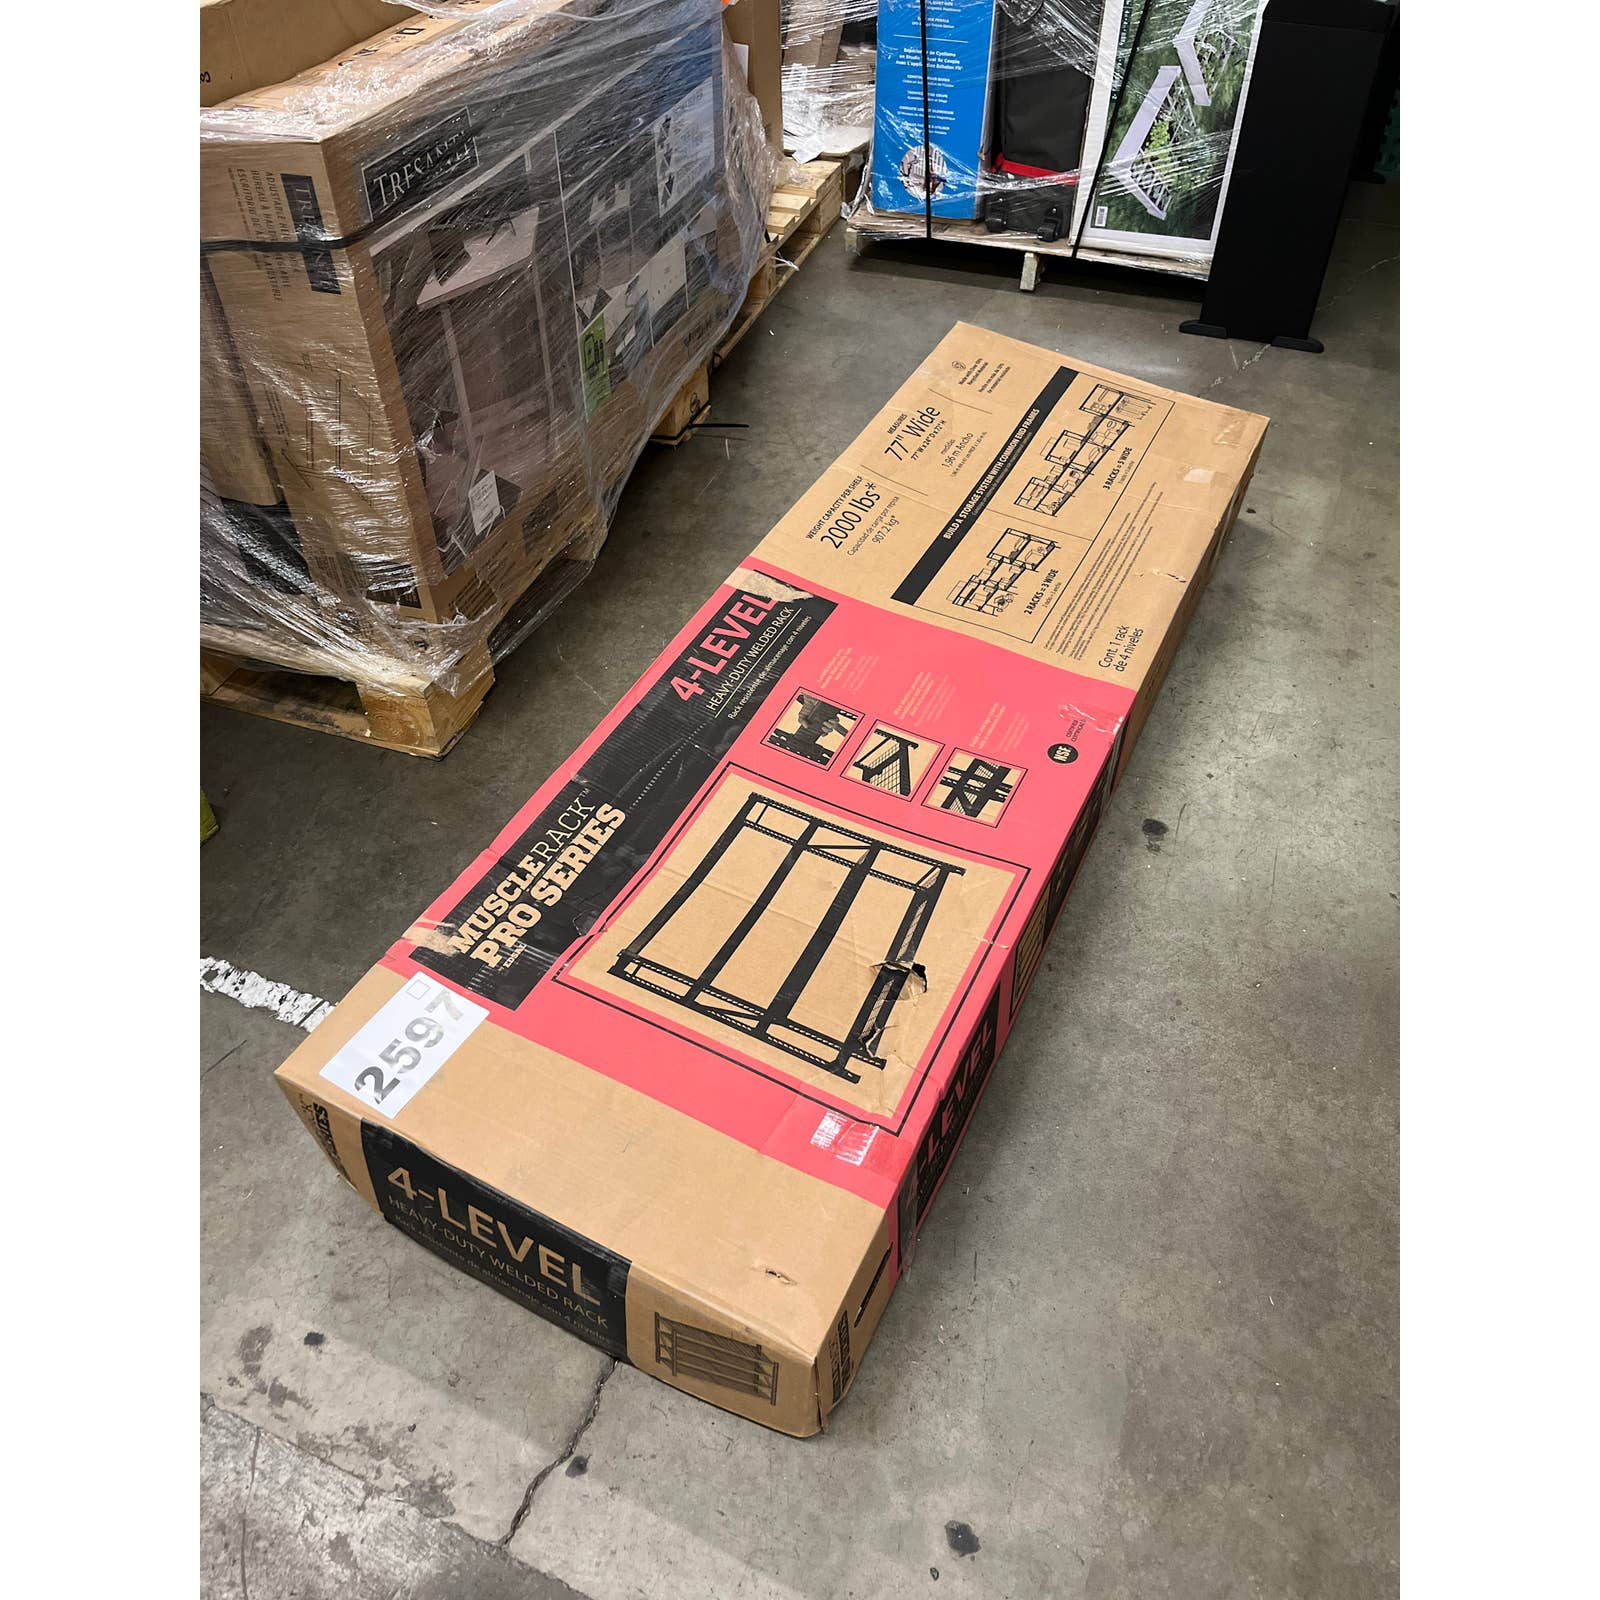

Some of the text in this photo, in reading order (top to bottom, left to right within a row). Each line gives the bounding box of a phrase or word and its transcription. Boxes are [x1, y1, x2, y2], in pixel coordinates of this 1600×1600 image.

[883, 403, 941, 460] 77" Wide
[886, 412, 908, 434] MEASURES
[1021, 407, 1040, 428] FRAMES
[954, 431, 974, 450] Ancho
[1014, 426, 1027, 439] END
[998, 437, 1020, 462] COMMON
[988, 460, 1004, 476] WITH
[1104, 467, 1120, 485] RACKS
[1118, 446, 1133, 460] WIDE
[975, 474, 995, 495] SYSTEM
[805, 474, 864, 540] WEIGHT CAPACITY PER SHELF
[954, 516, 964, 524] A
[958, 493, 981, 518] STORAGE
[819, 509, 863, 548] 2000
[846, 532, 871, 556] Capacidad
[865, 525, 874, 533] de
[870, 515, 885, 528] carga
[879, 508, 891, 517] por
[942, 521, 960, 539] BUILD
[1026, 590, 1044, 610] RACKS
[1043, 567, 1059, 584] WIDE
[794, 614, 812, 632] niveles
[666, 587, 779, 700] 4-LEVEL
[784, 634, 797, 645] con
[1097, 644, 1119, 668] Cont.
[1112, 623, 1130, 641] rack
[1112, 659, 1128, 672] de
[1121, 626, 1144, 654] niveles
[705, 605, 794, 711] HEAVY-DUTY WELDED RACK
[761, 642, 789, 672] almacenaje
[756, 670, 767, 679] de
[736, 677, 762, 706] resistente
[726, 703, 743, 720] Rack
[1052, 746, 1072, 761] NSF
[469, 799, 629, 968] PRO SERIES
[353, 987, 464, 1105] 2597
[385, 1165, 599, 1307] 4-LEVEL
[389, 1194, 607, 1330] HEAVY-DUTY WELDED RACK
